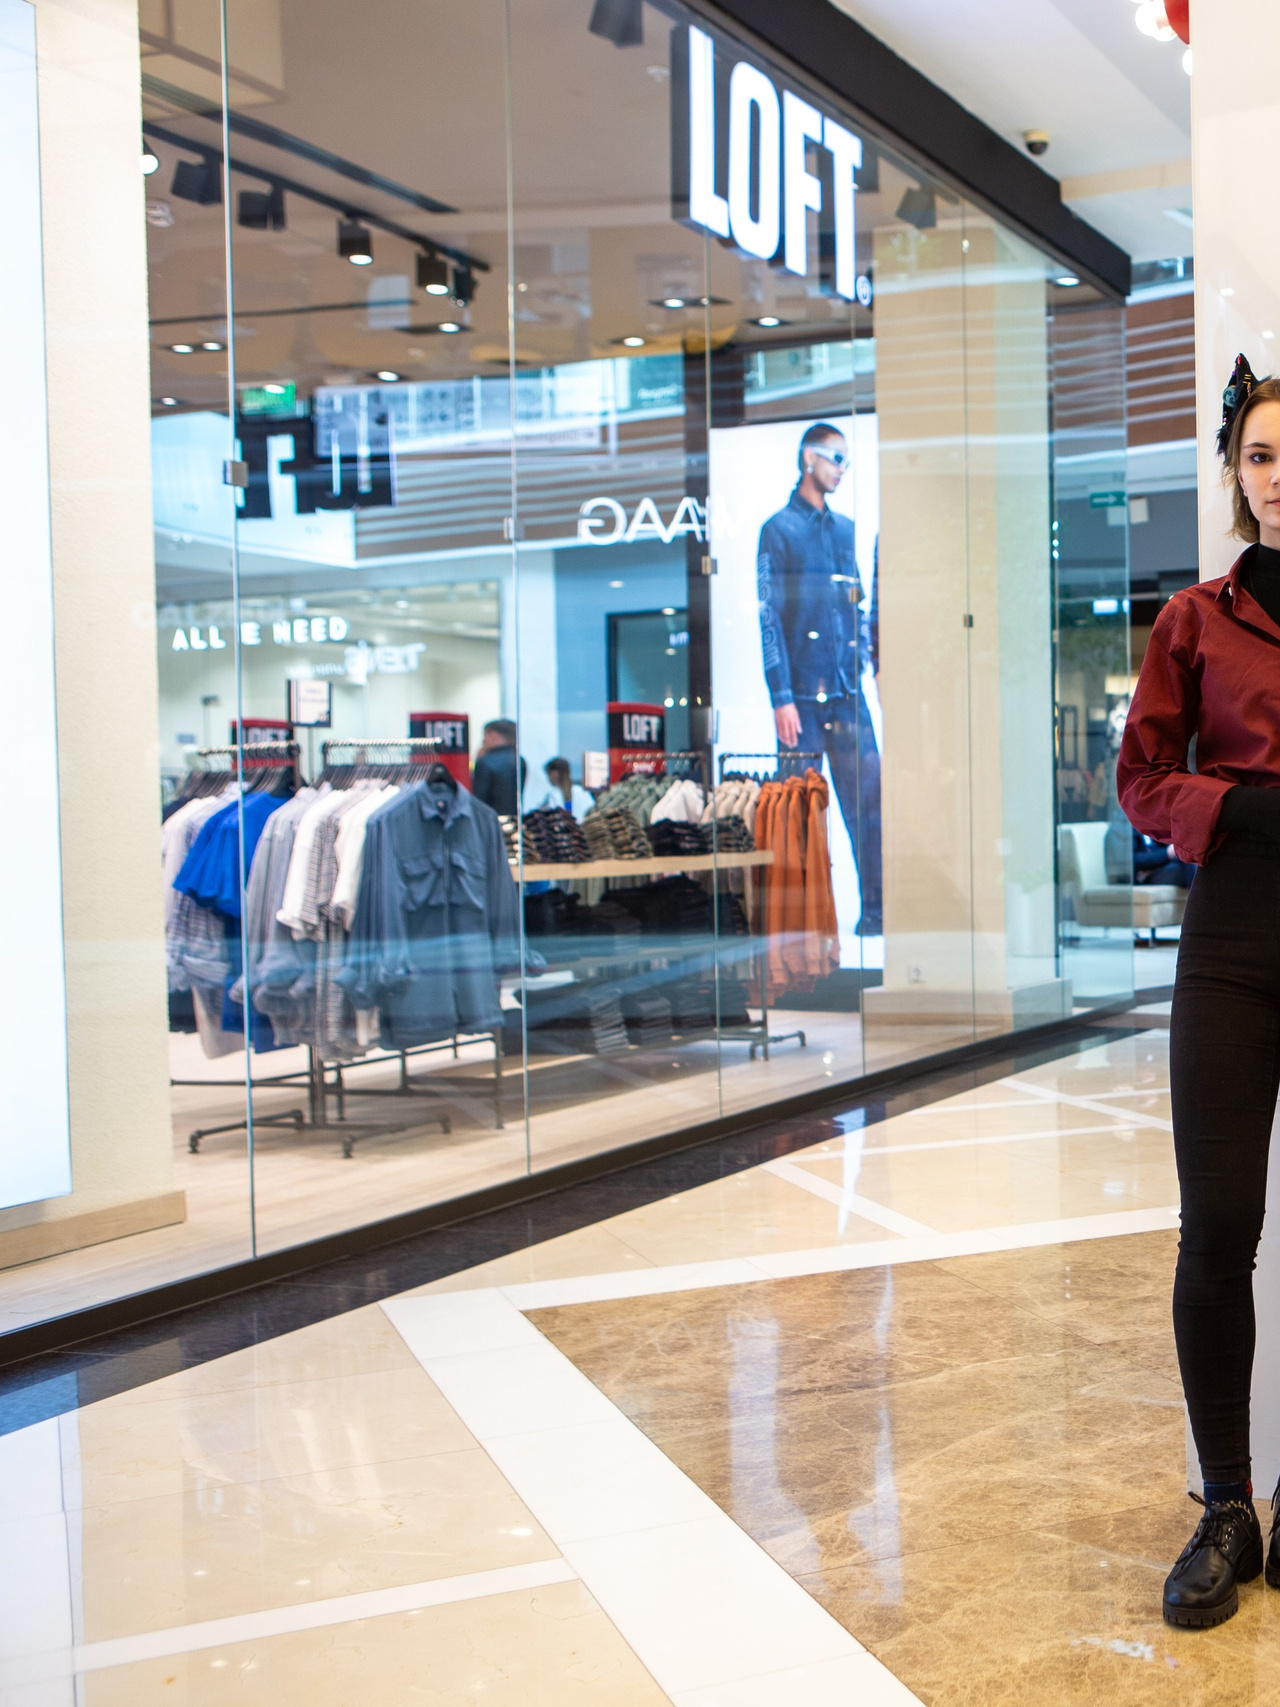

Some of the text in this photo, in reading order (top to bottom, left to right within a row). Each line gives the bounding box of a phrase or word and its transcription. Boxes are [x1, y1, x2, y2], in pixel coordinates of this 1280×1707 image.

[689, 25, 863, 301] LOFT
[172, 625, 226, 651] ALL
[273, 616, 349, 645] NEED
[623, 713, 660, 743] LOFT
